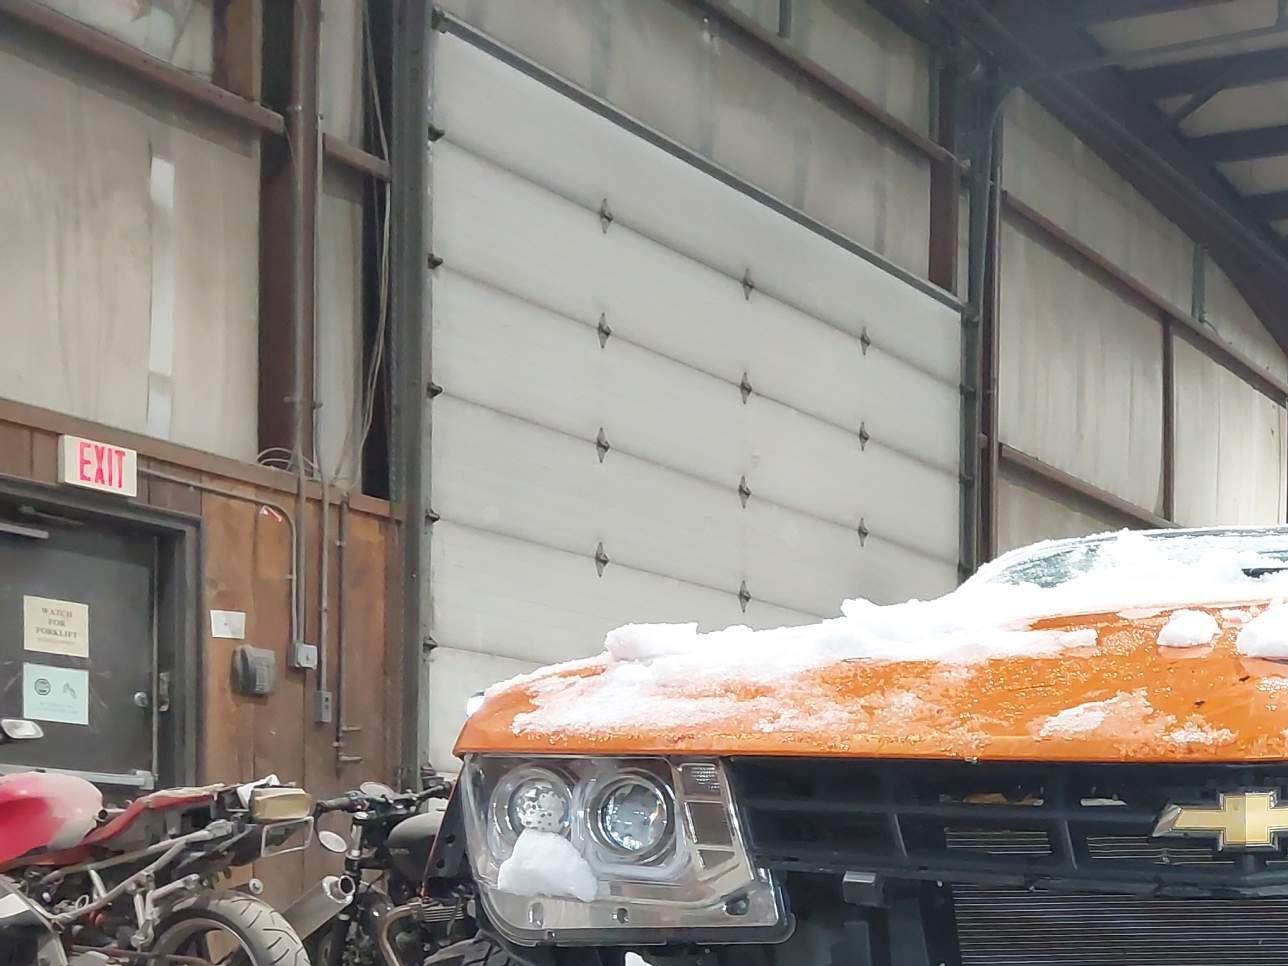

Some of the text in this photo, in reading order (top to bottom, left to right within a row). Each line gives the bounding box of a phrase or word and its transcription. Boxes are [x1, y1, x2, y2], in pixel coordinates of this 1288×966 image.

[79, 441, 126, 489] EXIT
[41, 607, 73, 618] WATCH
[48, 618, 65, 627] FOR
[35, 626, 78, 639] FORKLIFT
